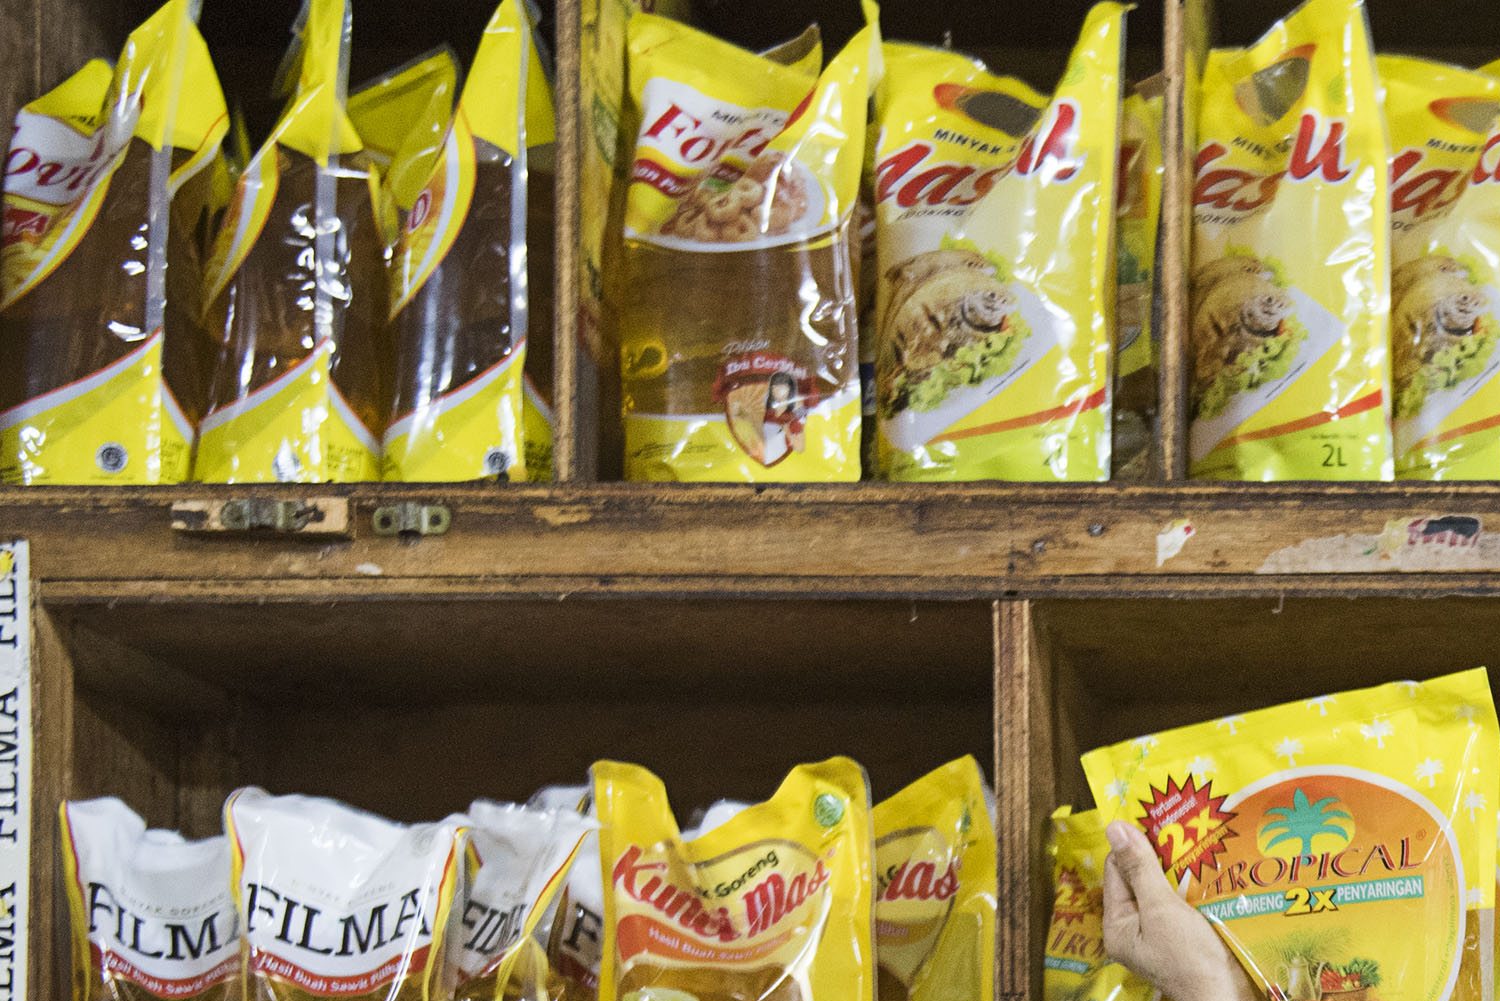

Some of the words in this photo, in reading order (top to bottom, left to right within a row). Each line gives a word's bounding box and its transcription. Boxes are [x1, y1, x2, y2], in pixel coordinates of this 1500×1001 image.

[1321, 443, 1348, 468] 2L
[714, 849, 780, 898] Goreng
[1207, 835, 1424, 897] TROPICAL
[247, 883, 430, 957] FILMA
[743, 857, 830, 939] Mas
[1283, 886, 1339, 917] 2x
[1336, 878, 1424, 903] PENYARINGAN
